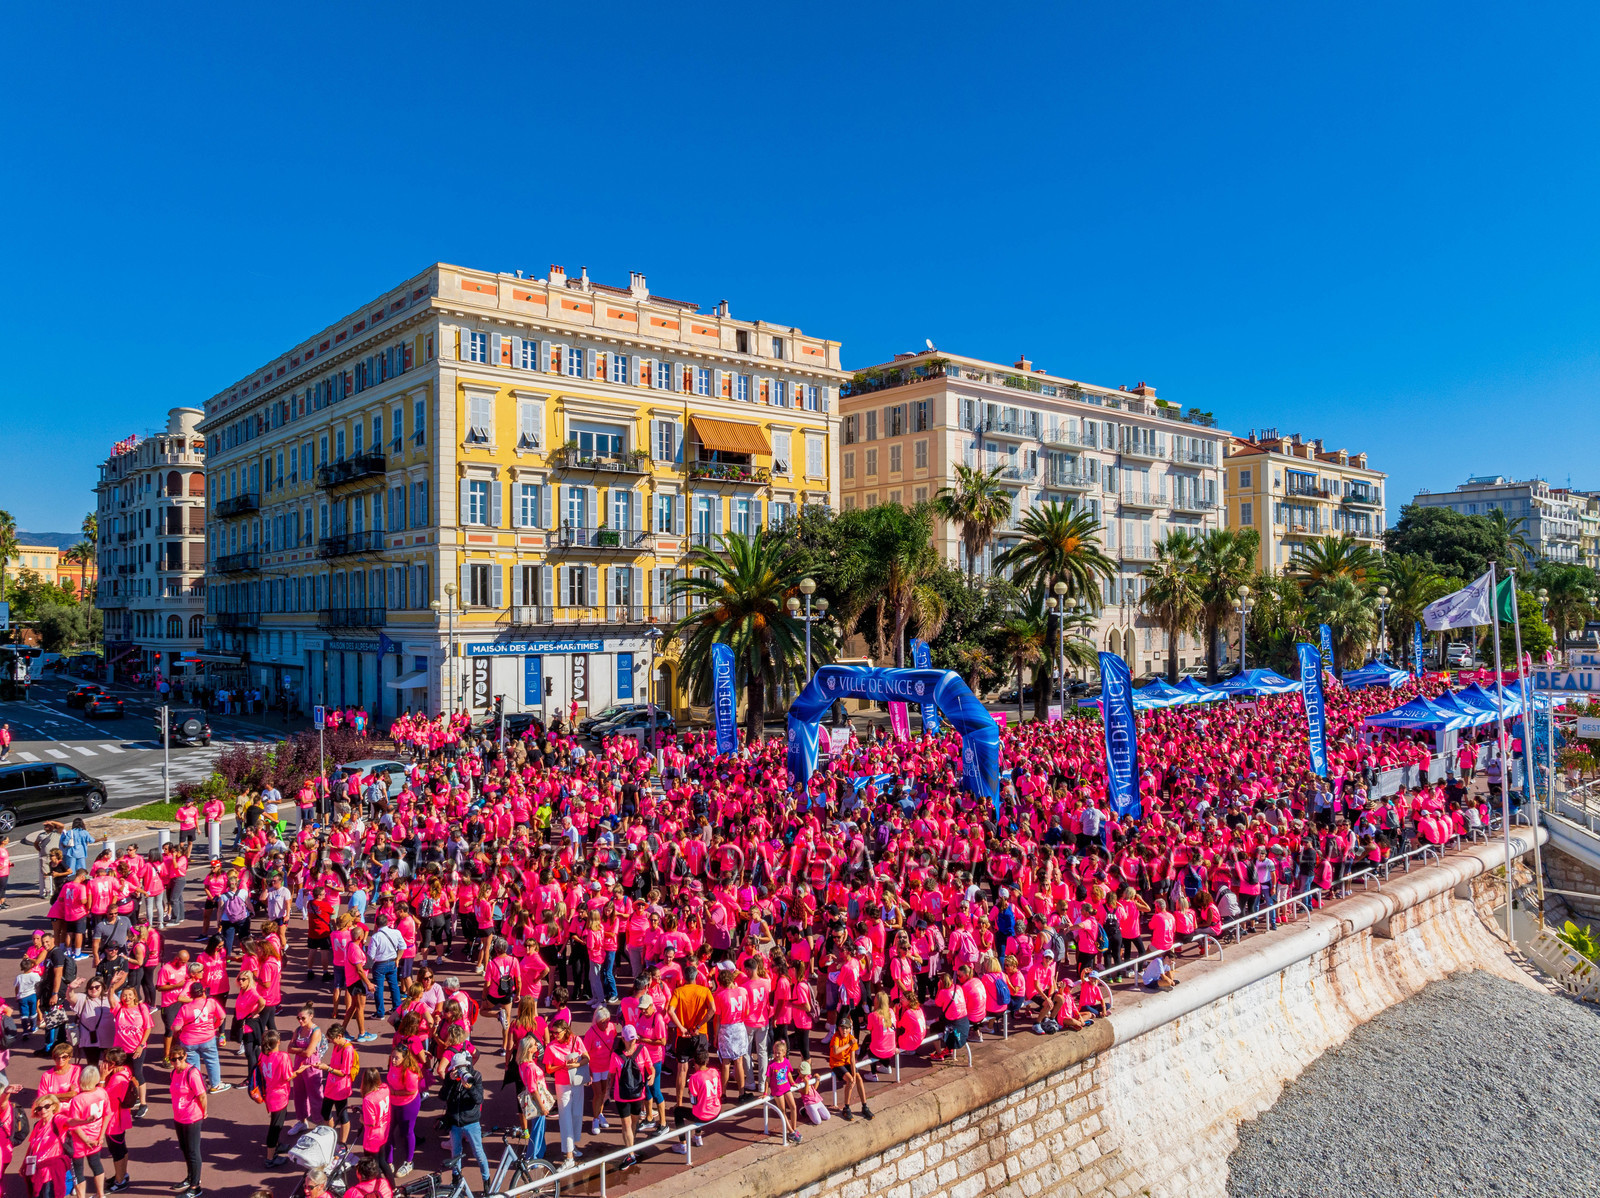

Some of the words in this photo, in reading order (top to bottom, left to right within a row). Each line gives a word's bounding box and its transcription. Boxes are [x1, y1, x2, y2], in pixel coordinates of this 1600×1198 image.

[329, 642, 346, 650] MAISON
[473, 644, 507, 652] MAISON
[528, 643, 599, 652] ALPES-MARITIMES
[917, 652, 928, 668] ICE
[475, 660, 488, 706] VOUS
[574, 656, 585, 699] VOUS
[718, 660, 731, 689] NICE
[839, 676, 866, 692] VILLE
[869, 678, 884, 693] DE
[885, 680, 913, 695] NICE
[1304, 662, 1317, 695] NICE
[1536, 672, 1592, 690] BEAU
[719, 691, 732, 707] DE
[1108, 676, 1126, 716] NICE
[1307, 698, 1319, 715] DE
[721, 710, 732, 739] VILLE
[1112, 720, 1129, 742] DE
[1310, 718, 1322, 754] VILLE
[1113, 747, 1132, 790] VILLE
